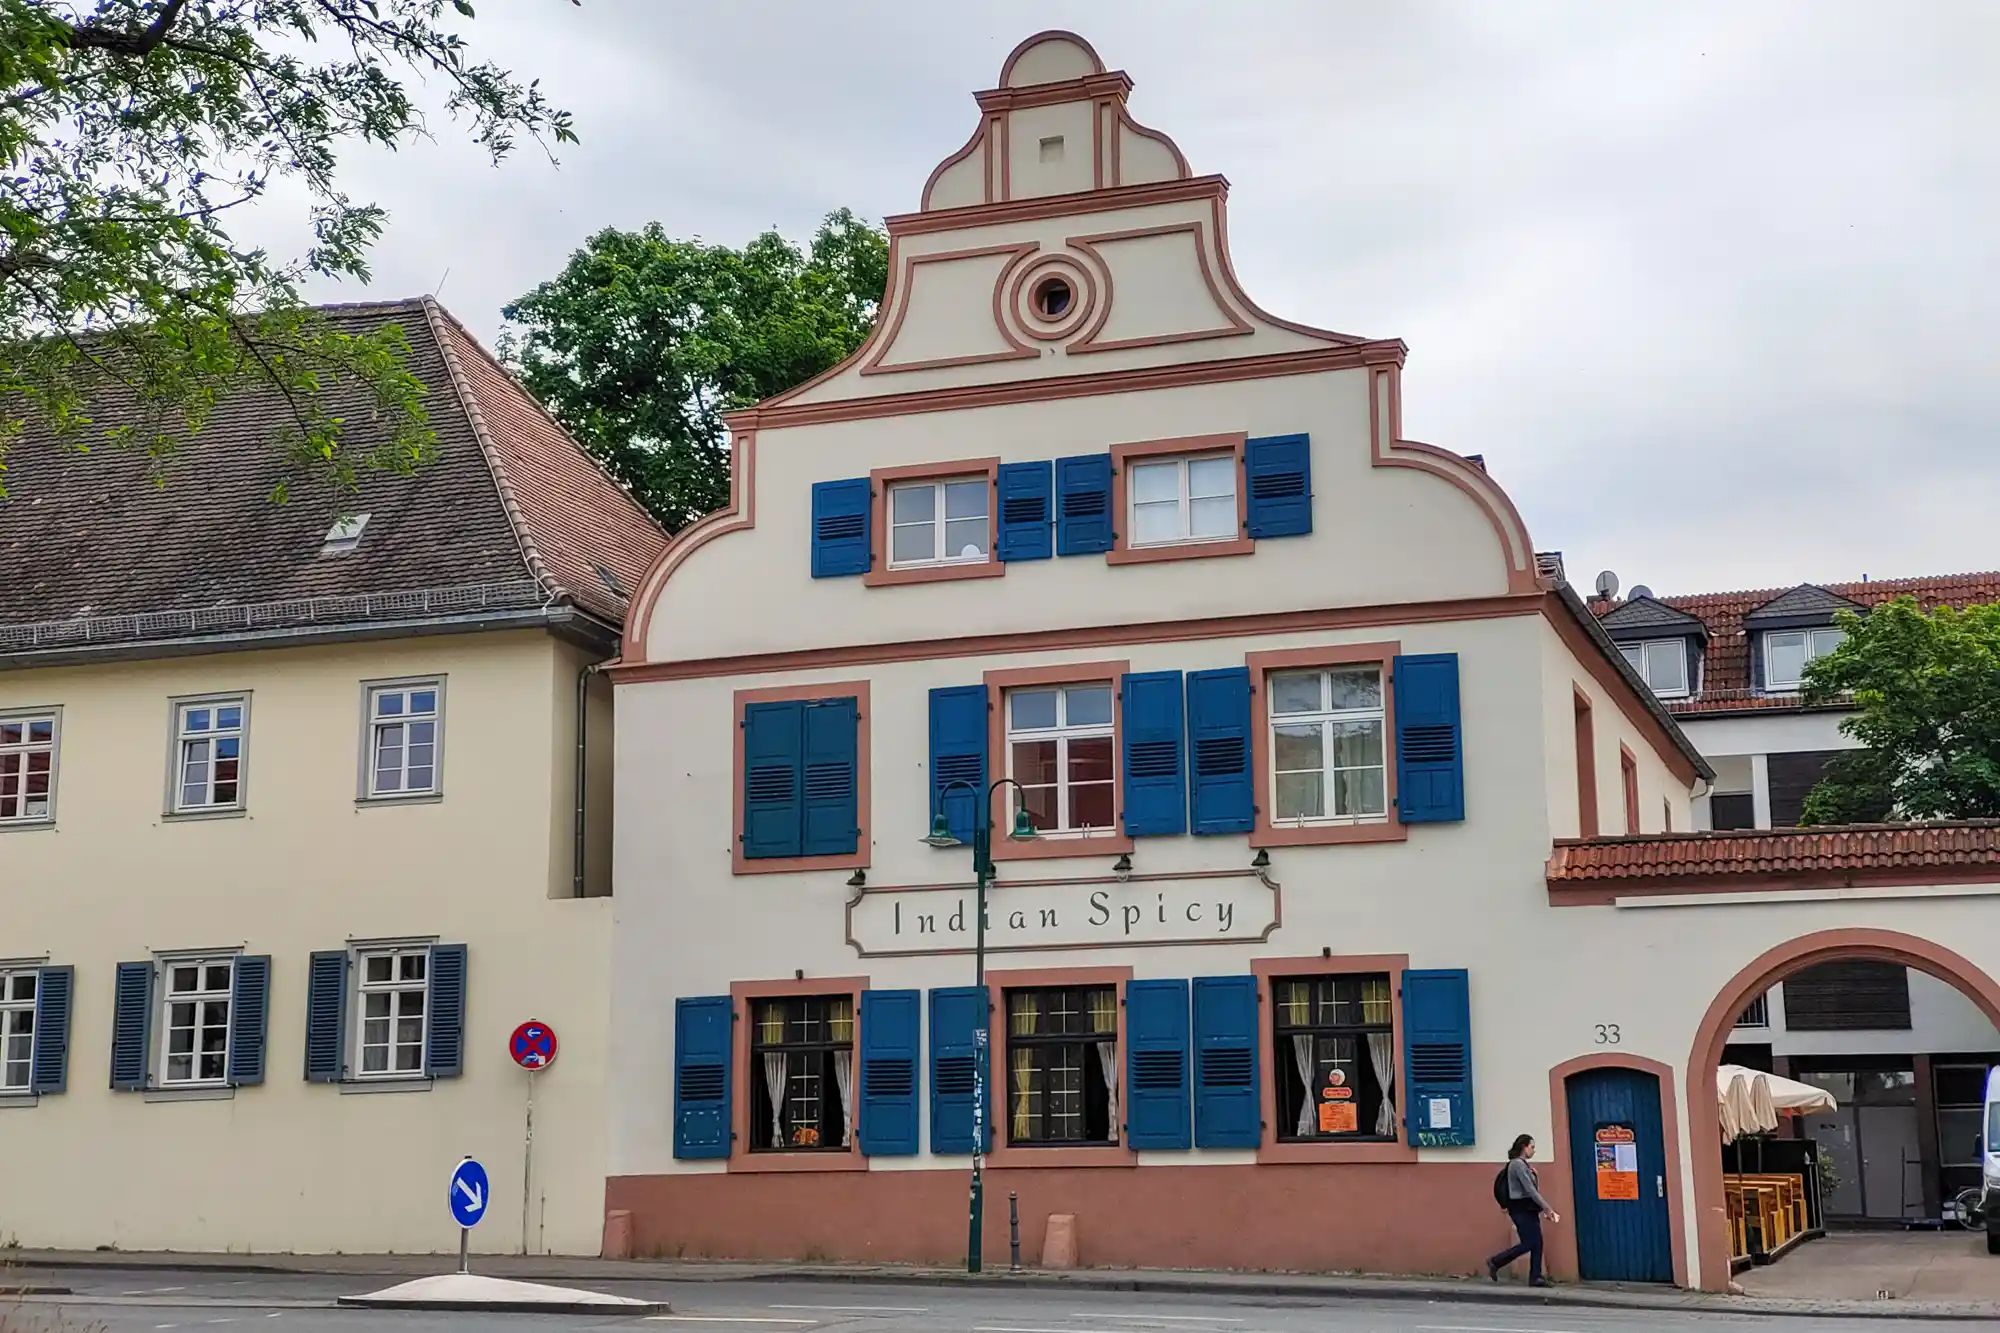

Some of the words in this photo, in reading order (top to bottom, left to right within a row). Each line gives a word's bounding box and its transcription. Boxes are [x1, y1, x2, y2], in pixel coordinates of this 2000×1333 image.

[894, 899, 1059, 935] Indian
[1088, 891, 1233, 935] Spicy
[1594, 1023, 1621, 1045] 33
